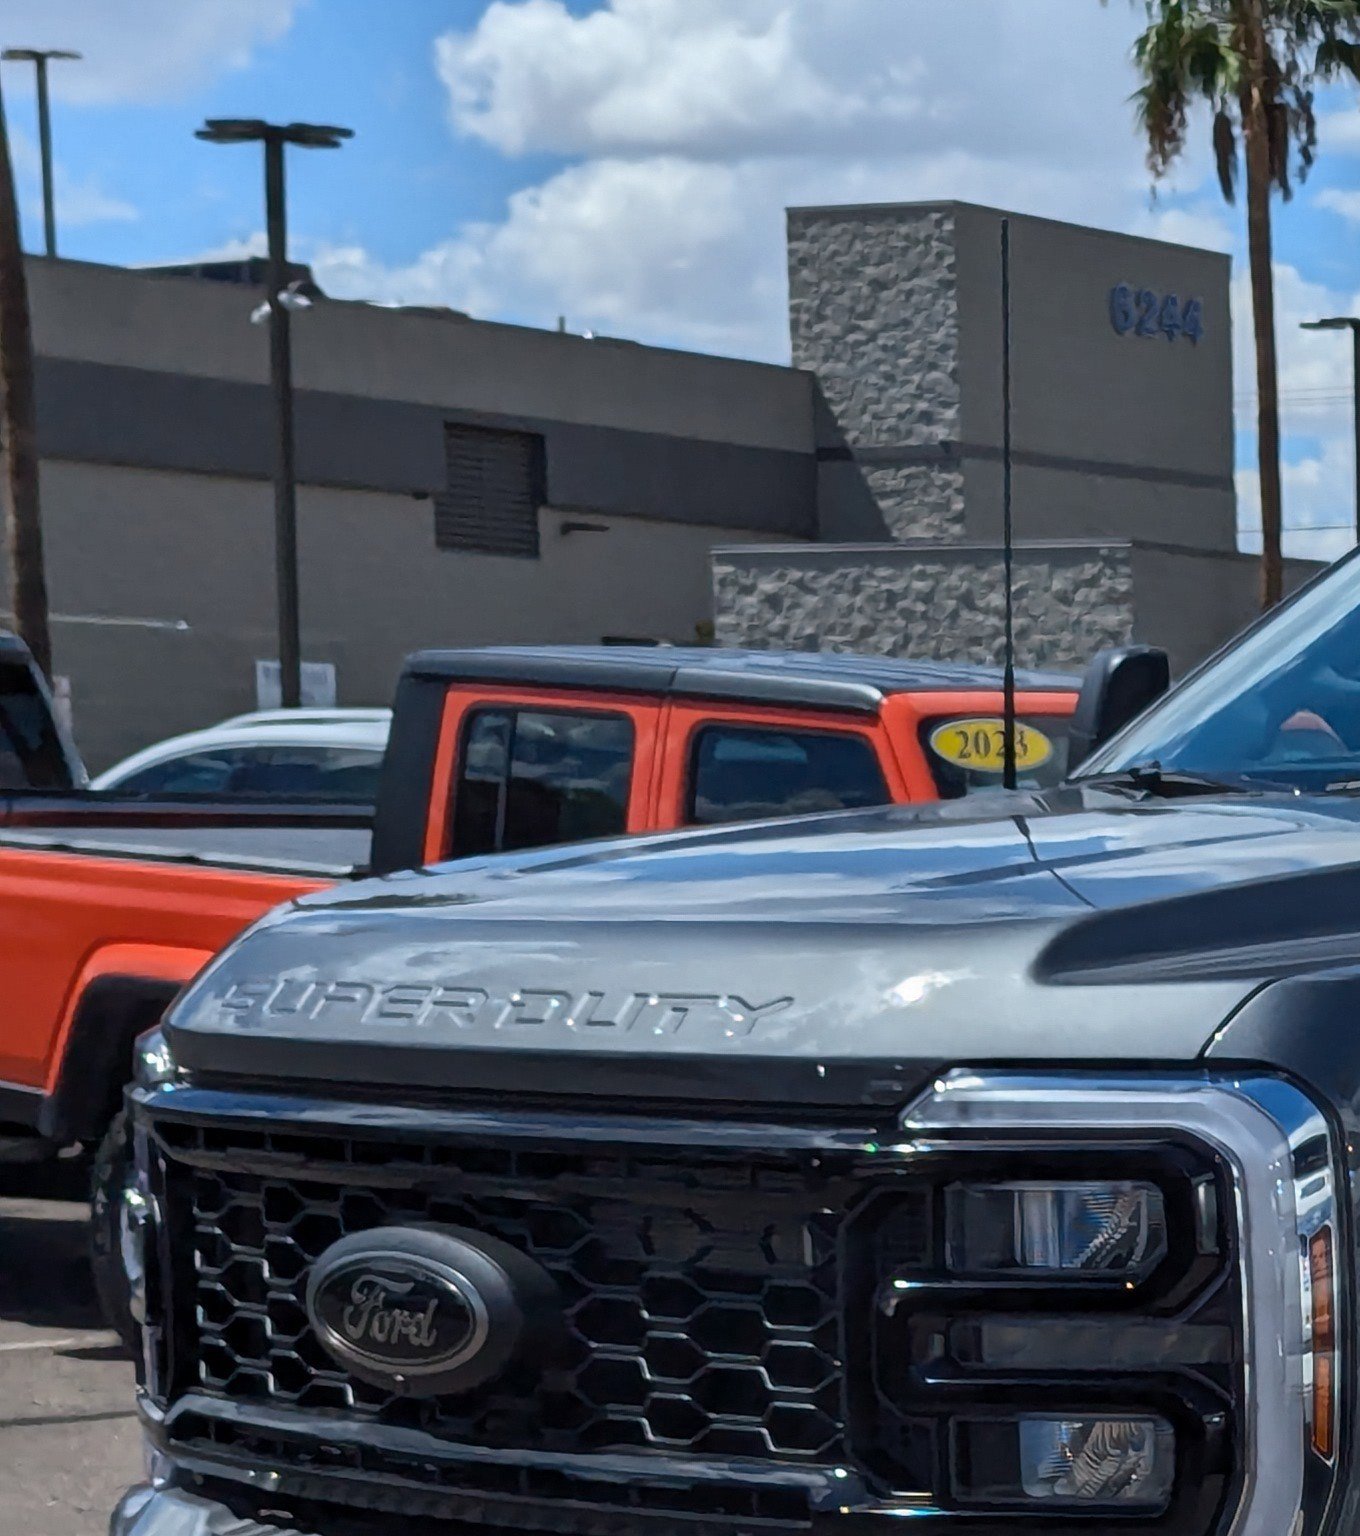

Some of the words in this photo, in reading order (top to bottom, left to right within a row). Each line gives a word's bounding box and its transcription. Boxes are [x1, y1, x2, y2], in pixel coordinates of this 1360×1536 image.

[1109, 281, 1204, 346] 6244
[208, 977, 490, 1028] SUPER
[494, 987, 795, 1036] DUTY
[342, 1273, 438, 1347] Ford
